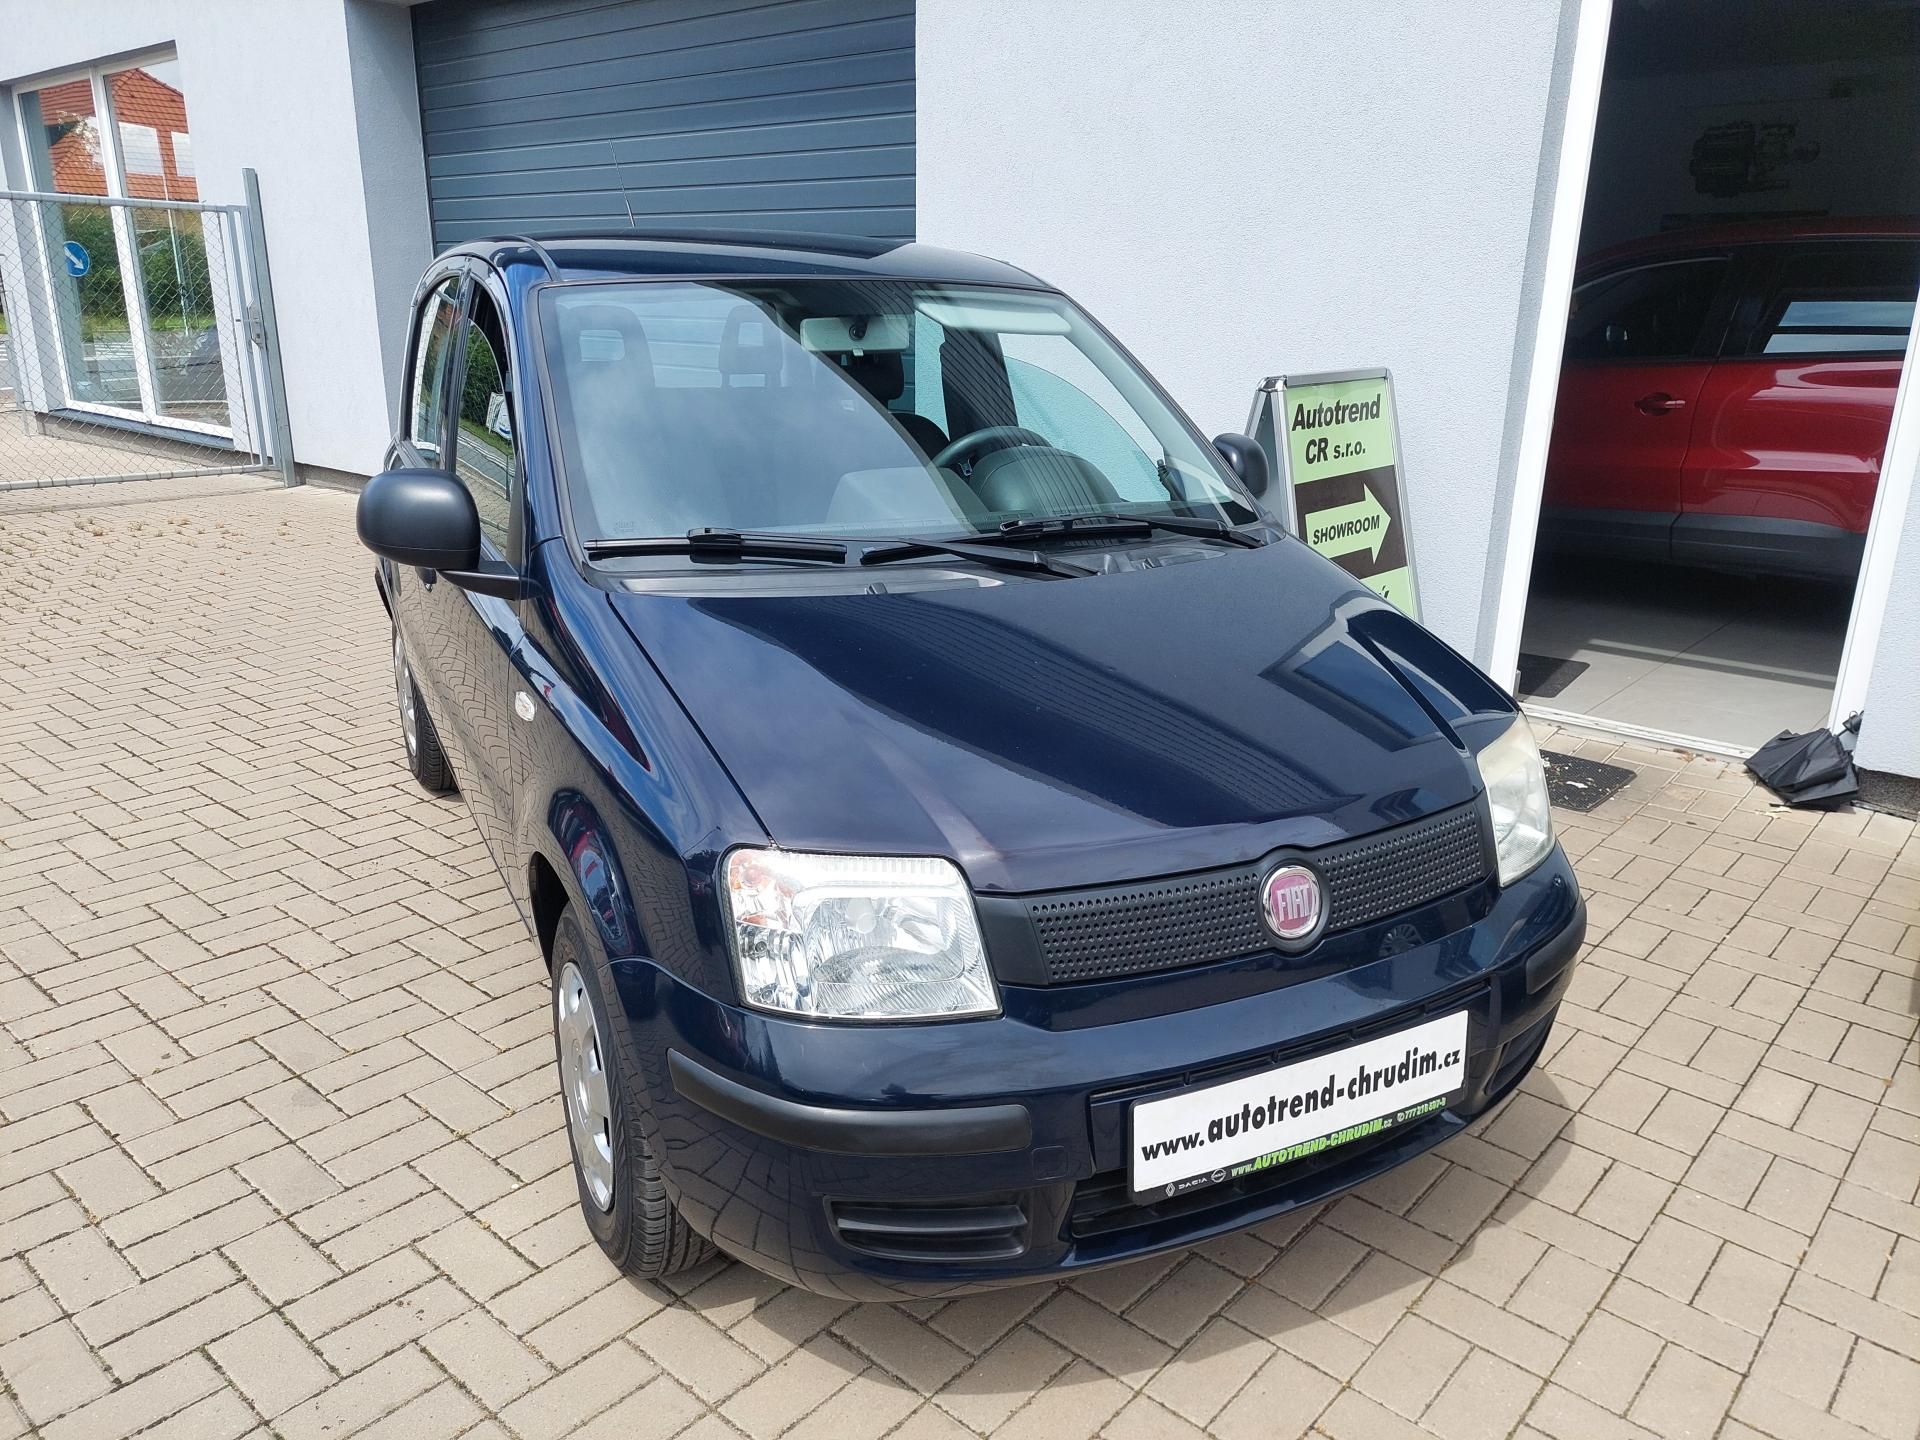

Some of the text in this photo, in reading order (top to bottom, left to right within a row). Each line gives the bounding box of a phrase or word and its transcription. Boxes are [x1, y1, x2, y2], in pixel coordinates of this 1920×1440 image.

[1292, 393, 1381, 431] Autotrend
[1305, 437, 1366, 464] CR s.r.o.
[1312, 514, 1380, 545] SHOWROOM
[1276, 883, 1311, 922] FIAT
[1141, 1047, 1461, 1161] www.autotrend-chrudim.cz
